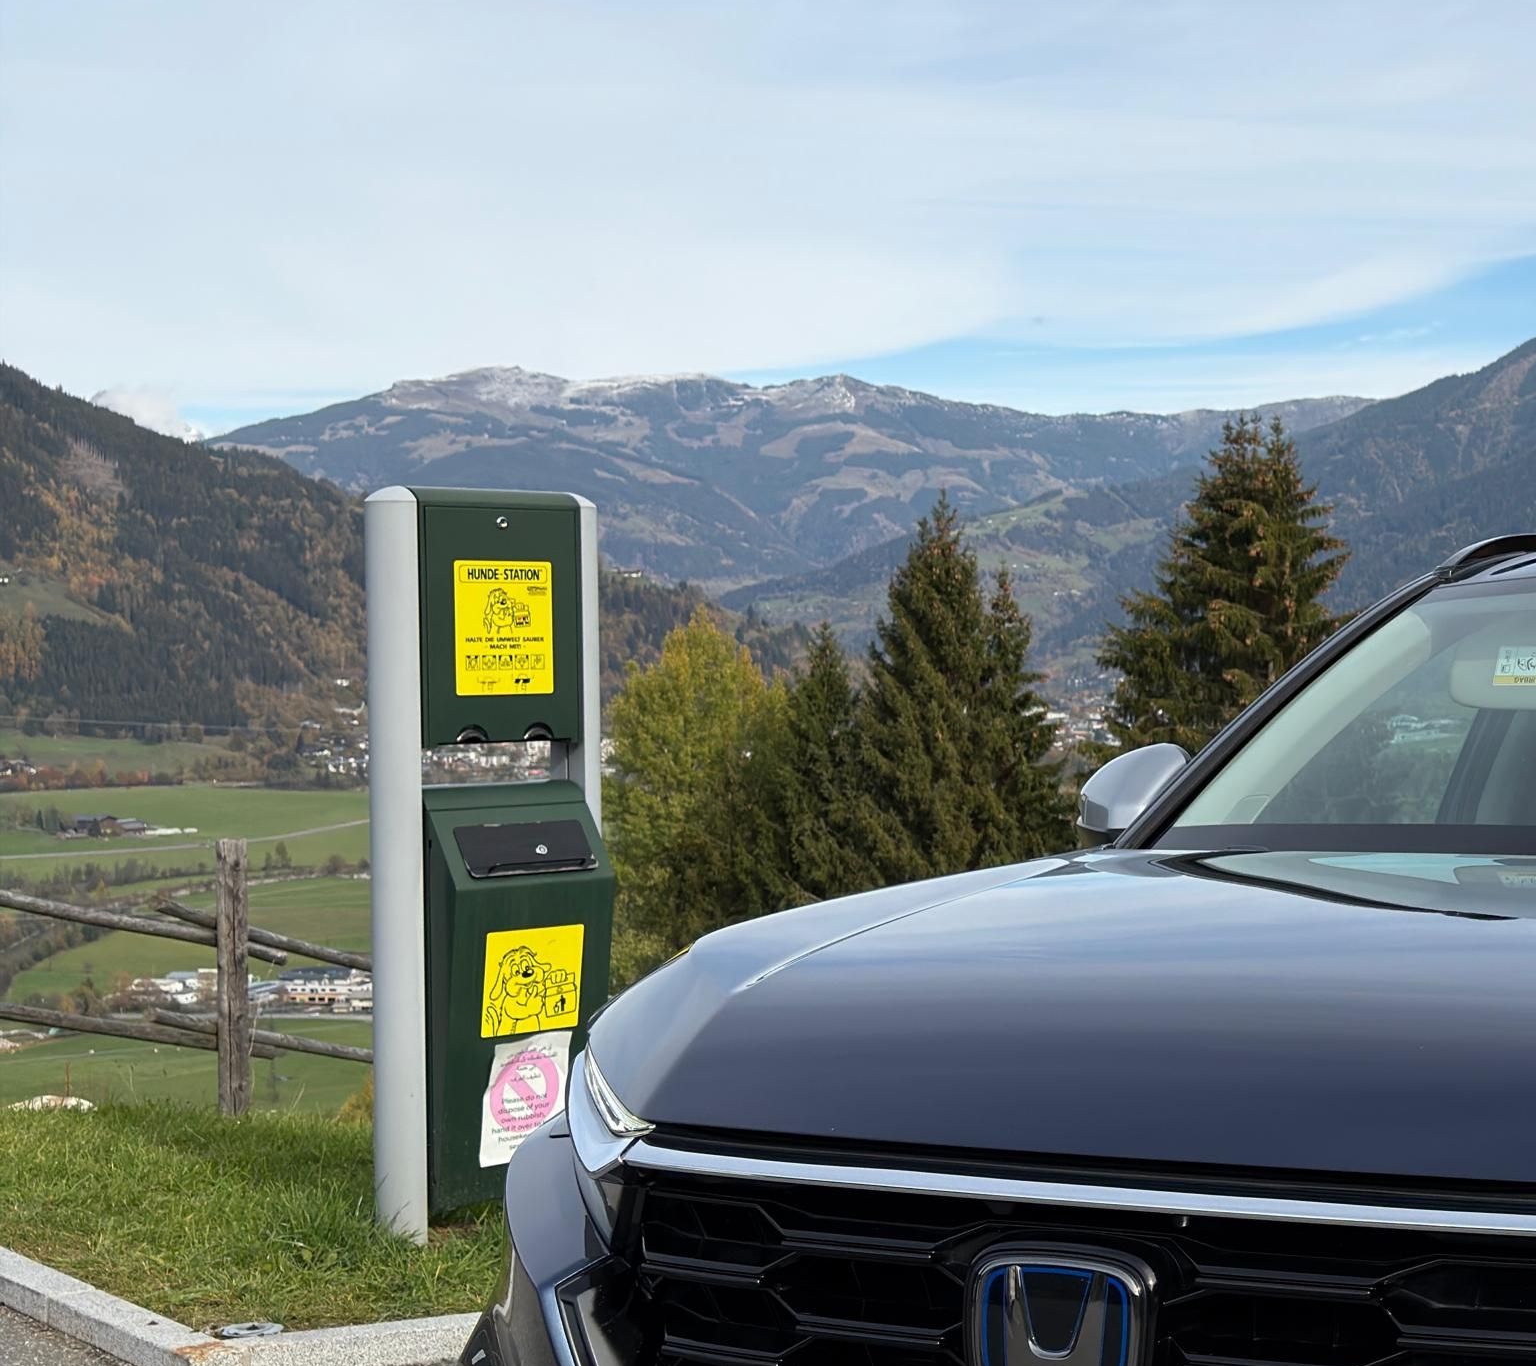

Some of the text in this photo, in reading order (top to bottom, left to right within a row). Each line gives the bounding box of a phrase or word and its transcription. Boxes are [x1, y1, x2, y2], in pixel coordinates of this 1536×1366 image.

[501, 1092, 548, 1105] Please do not
[498, 1101, 550, 1115] dispose of your
[501, 1116, 517, 1124] own
[491, 1124, 510, 1135] hand
[517, 1123, 532, 1131] over
